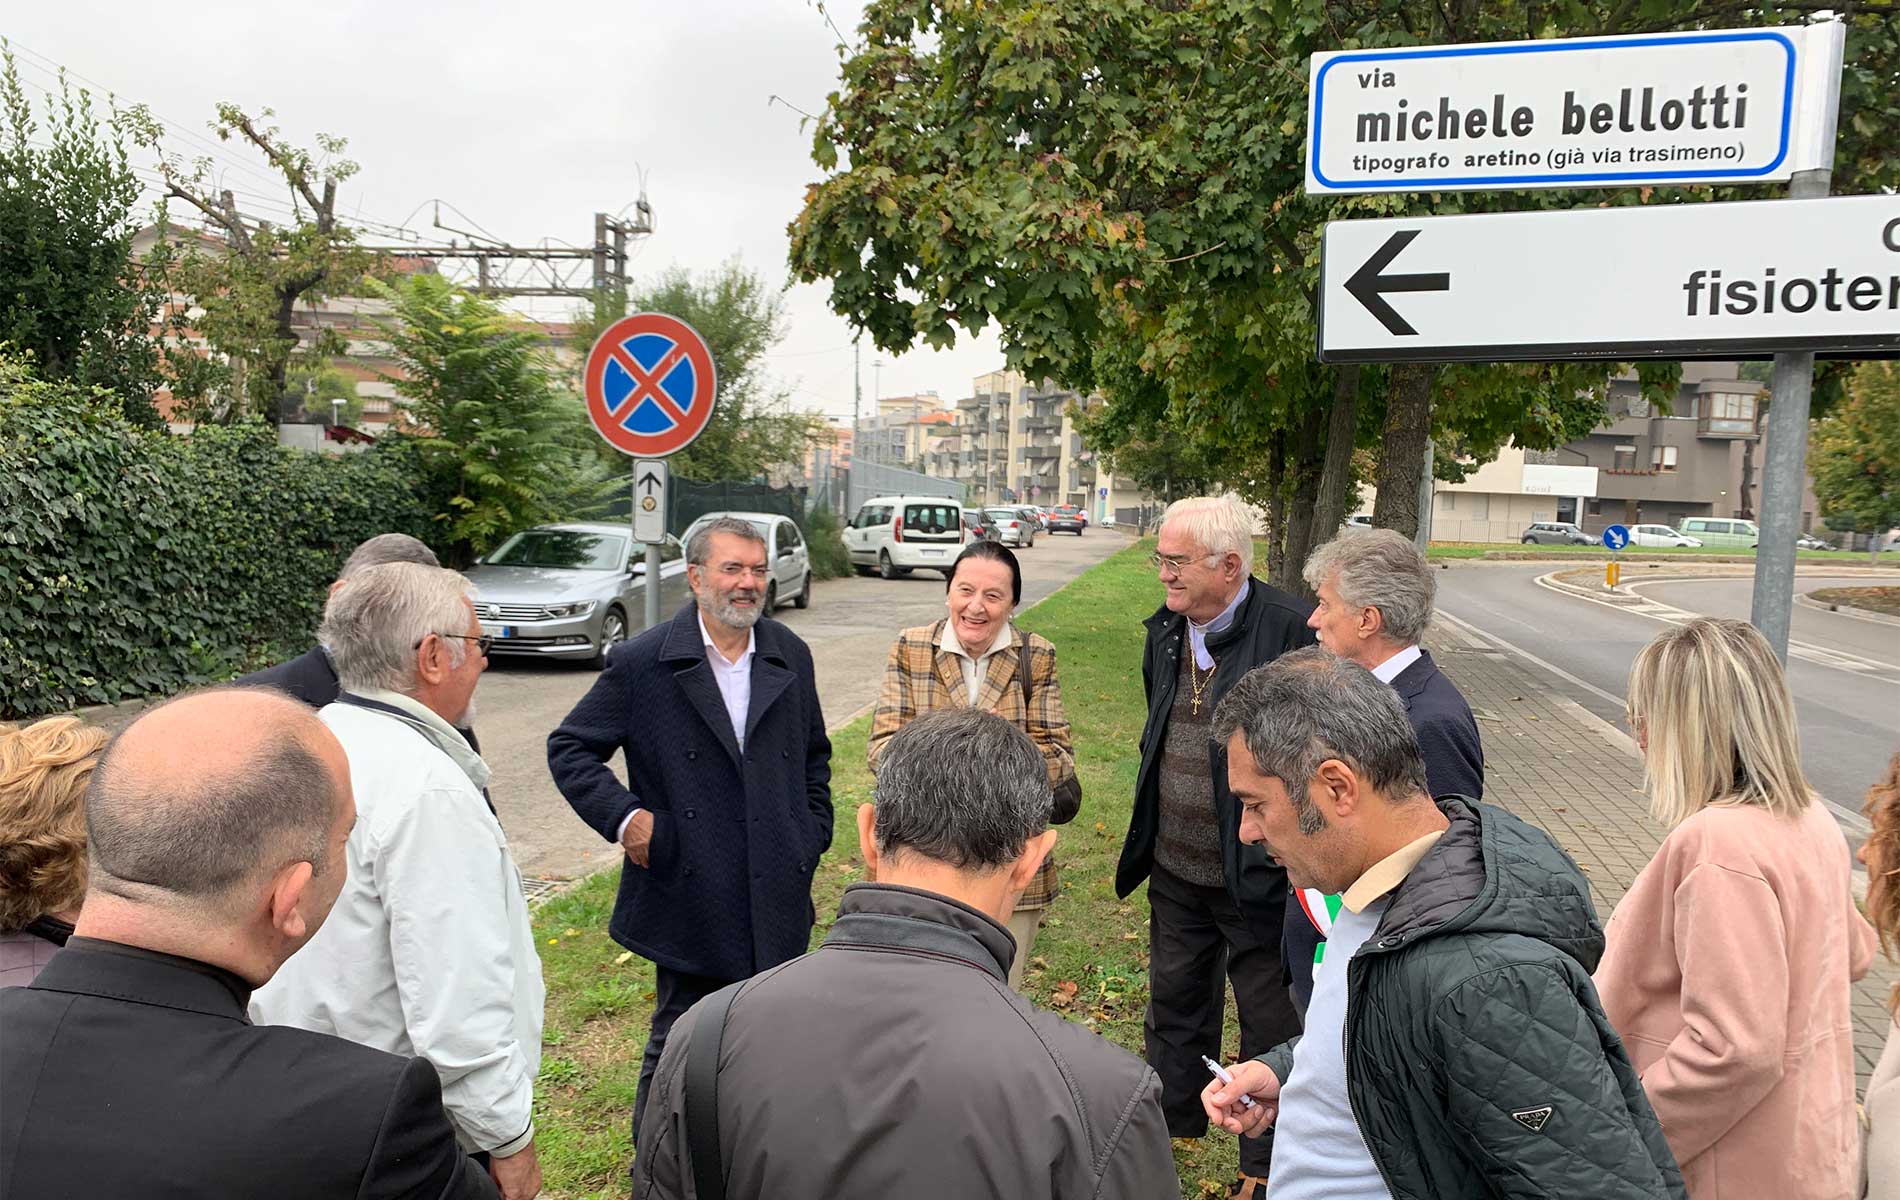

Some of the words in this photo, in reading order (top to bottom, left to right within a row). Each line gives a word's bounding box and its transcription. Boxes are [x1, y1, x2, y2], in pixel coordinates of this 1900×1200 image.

[1357, 67, 1396, 89] via
[1356, 94, 1534, 143] michele
[1562, 83, 1748, 135] bellotti
[1353, 152, 1450, 173] tipografo
[1464, 150, 1541, 167] aretino
[1547, 147, 1585, 169] (già
[1592, 147, 1622, 163] via
[1629, 141, 1745, 162] trasimeno)
